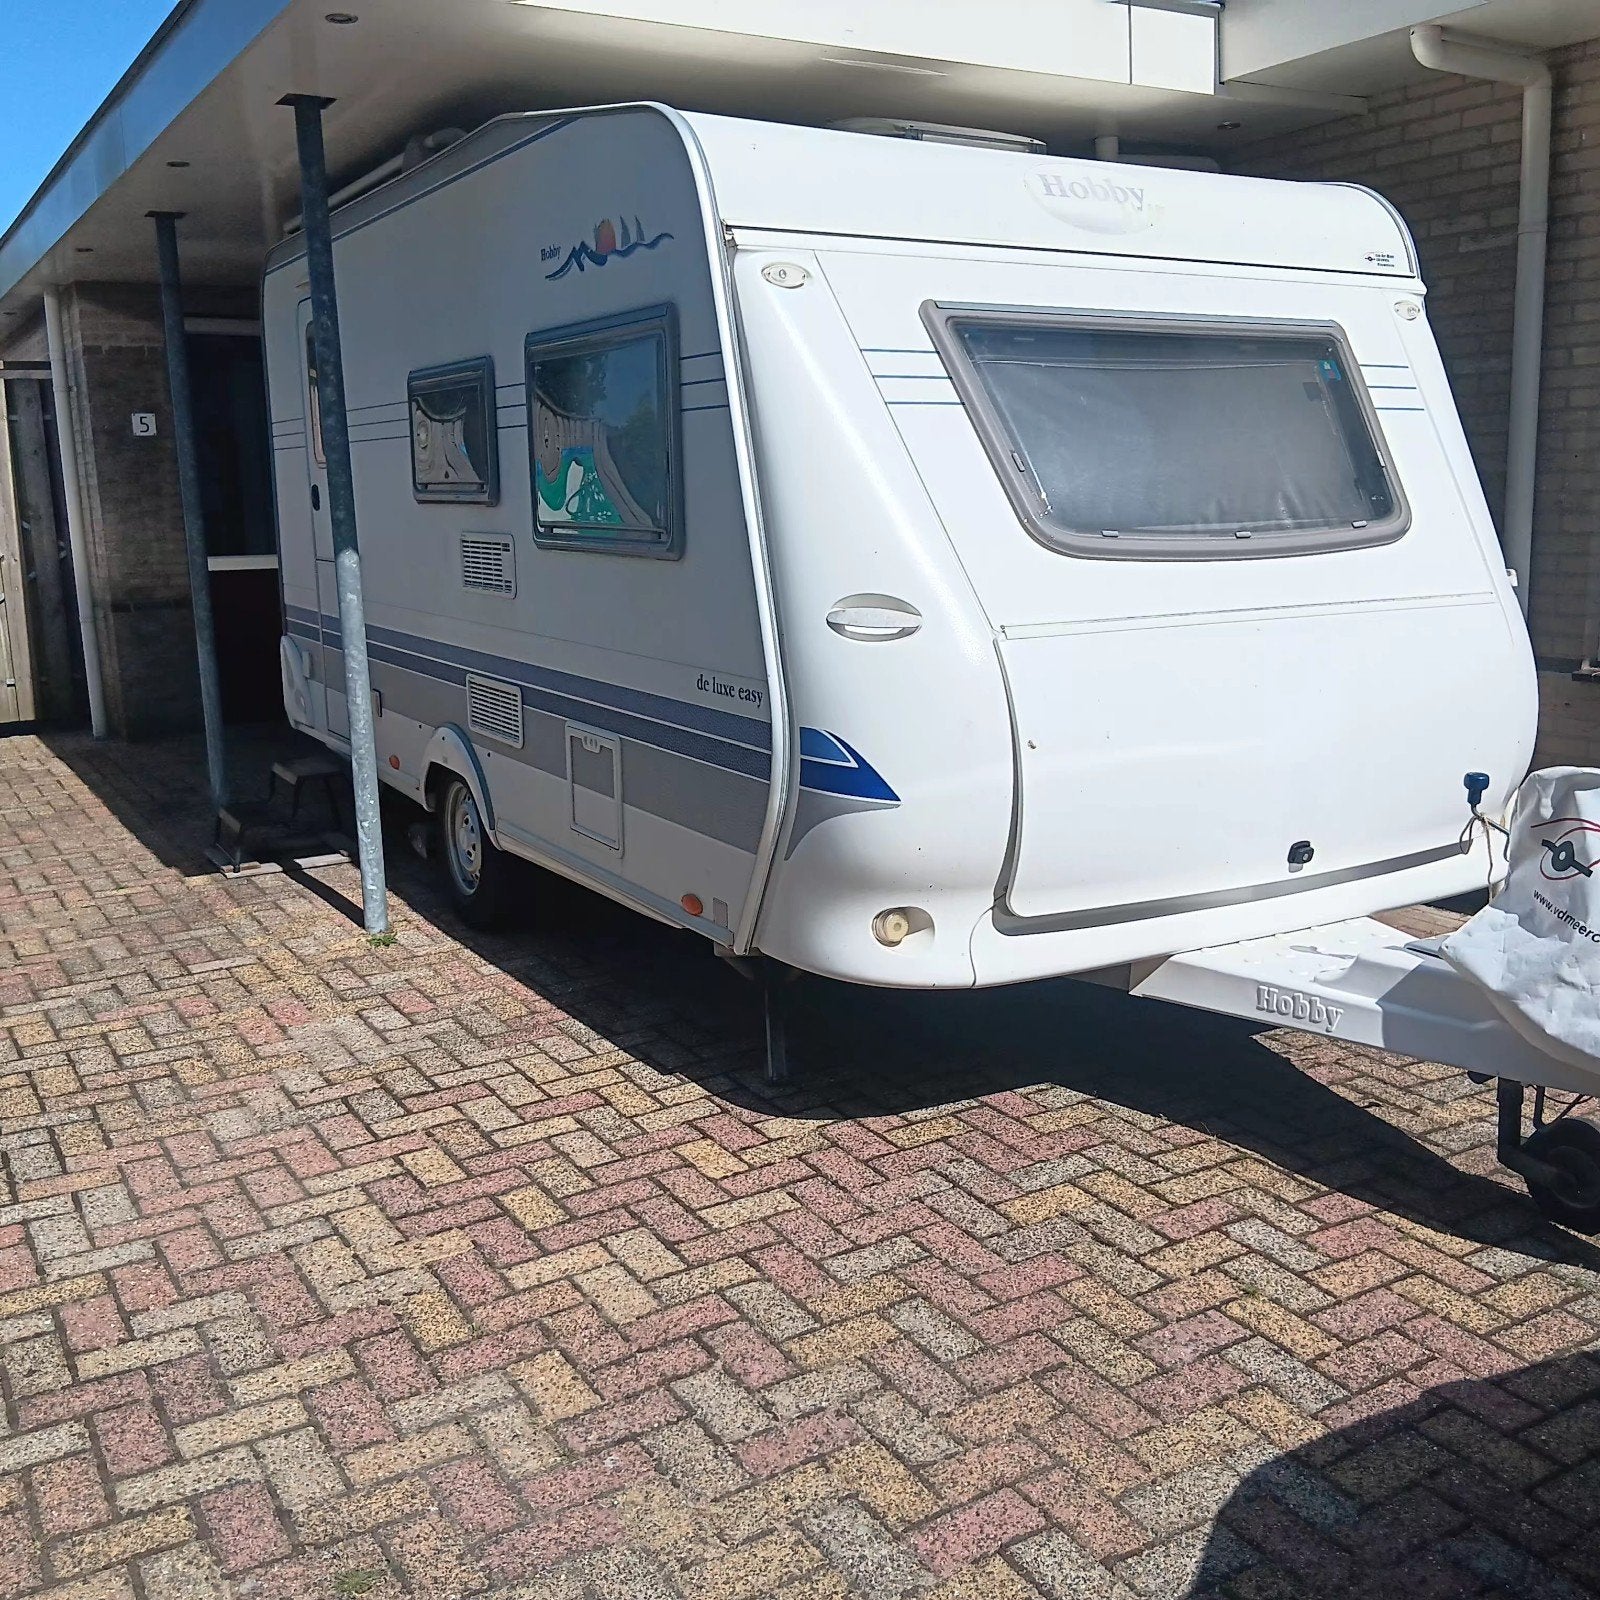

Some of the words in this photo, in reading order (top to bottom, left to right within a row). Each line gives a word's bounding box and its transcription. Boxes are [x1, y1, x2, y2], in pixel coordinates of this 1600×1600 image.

[1038, 173, 1144, 211] Hobby
[540, 244, 562, 261] Hobby
[139, 416, 150, 433] 5
[696, 673, 710, 691] de
[712, 676, 735, 698] luxe
[738, 687, 763, 708] easy
[1256, 985, 1344, 1033] Hobby
